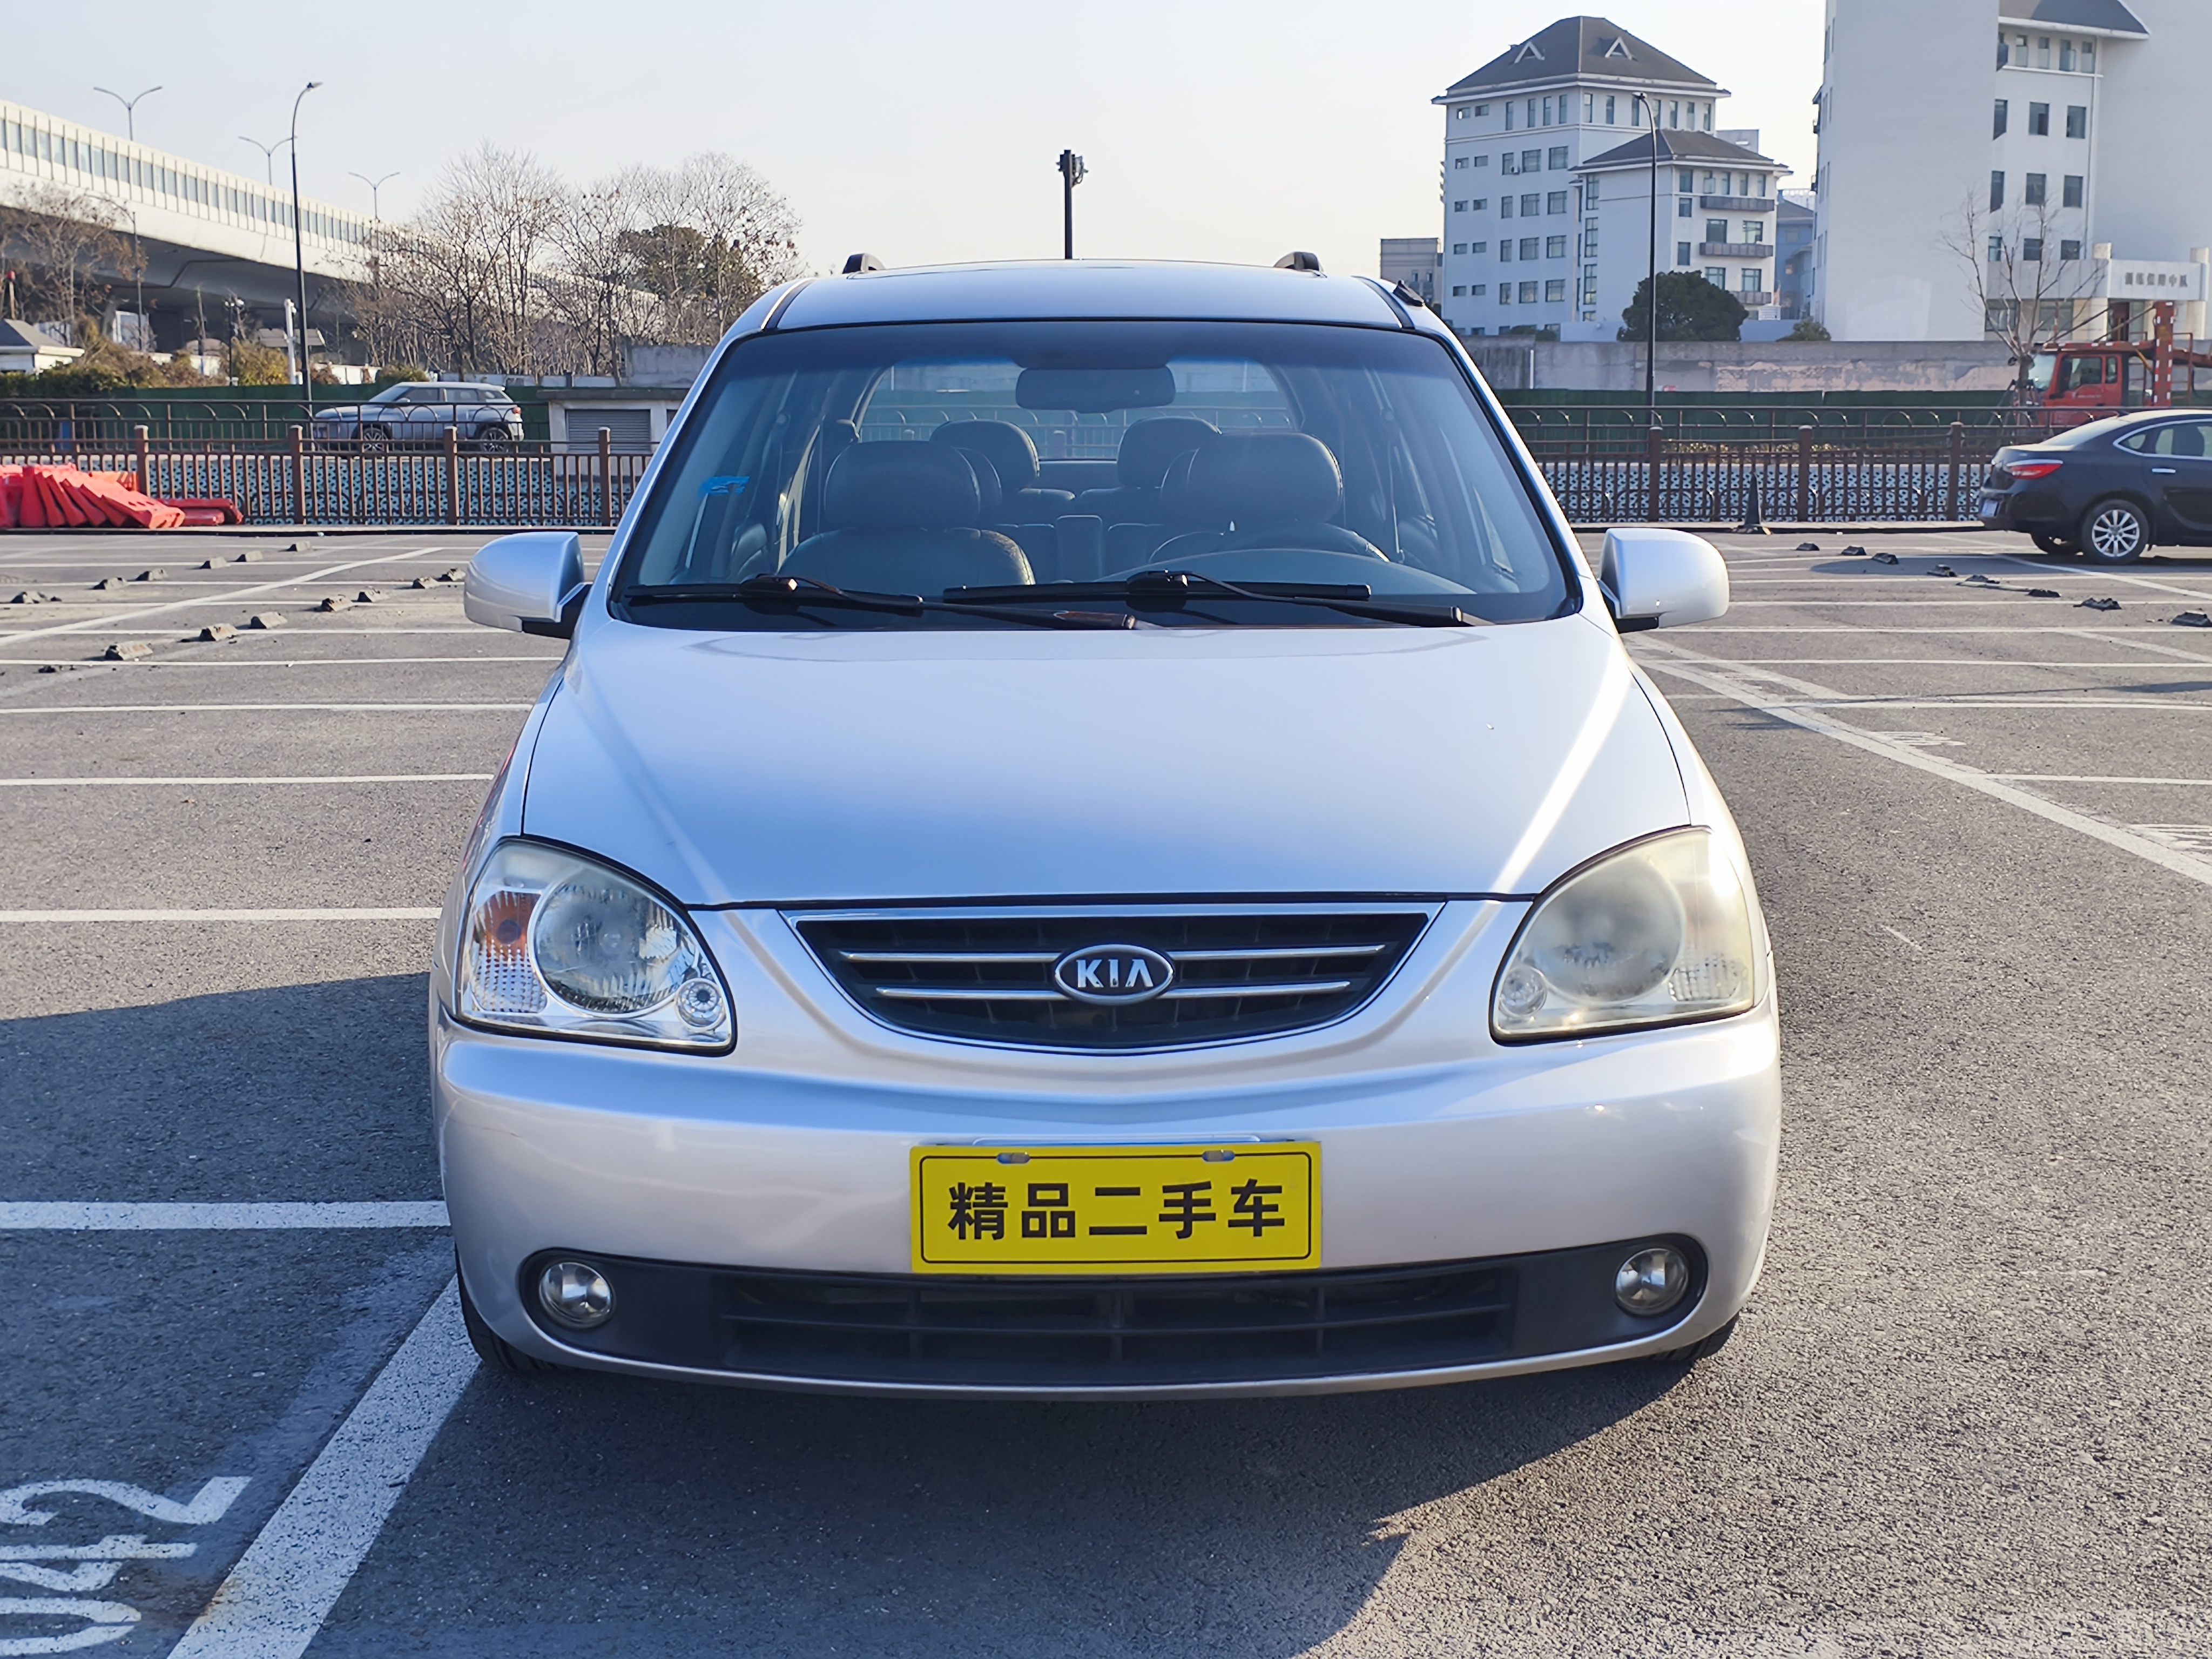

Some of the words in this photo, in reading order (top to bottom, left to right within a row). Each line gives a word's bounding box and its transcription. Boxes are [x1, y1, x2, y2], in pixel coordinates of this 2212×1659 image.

[1076, 959, 1154, 988] KIA
[948, 1179, 1284, 1240] 精品二手车
